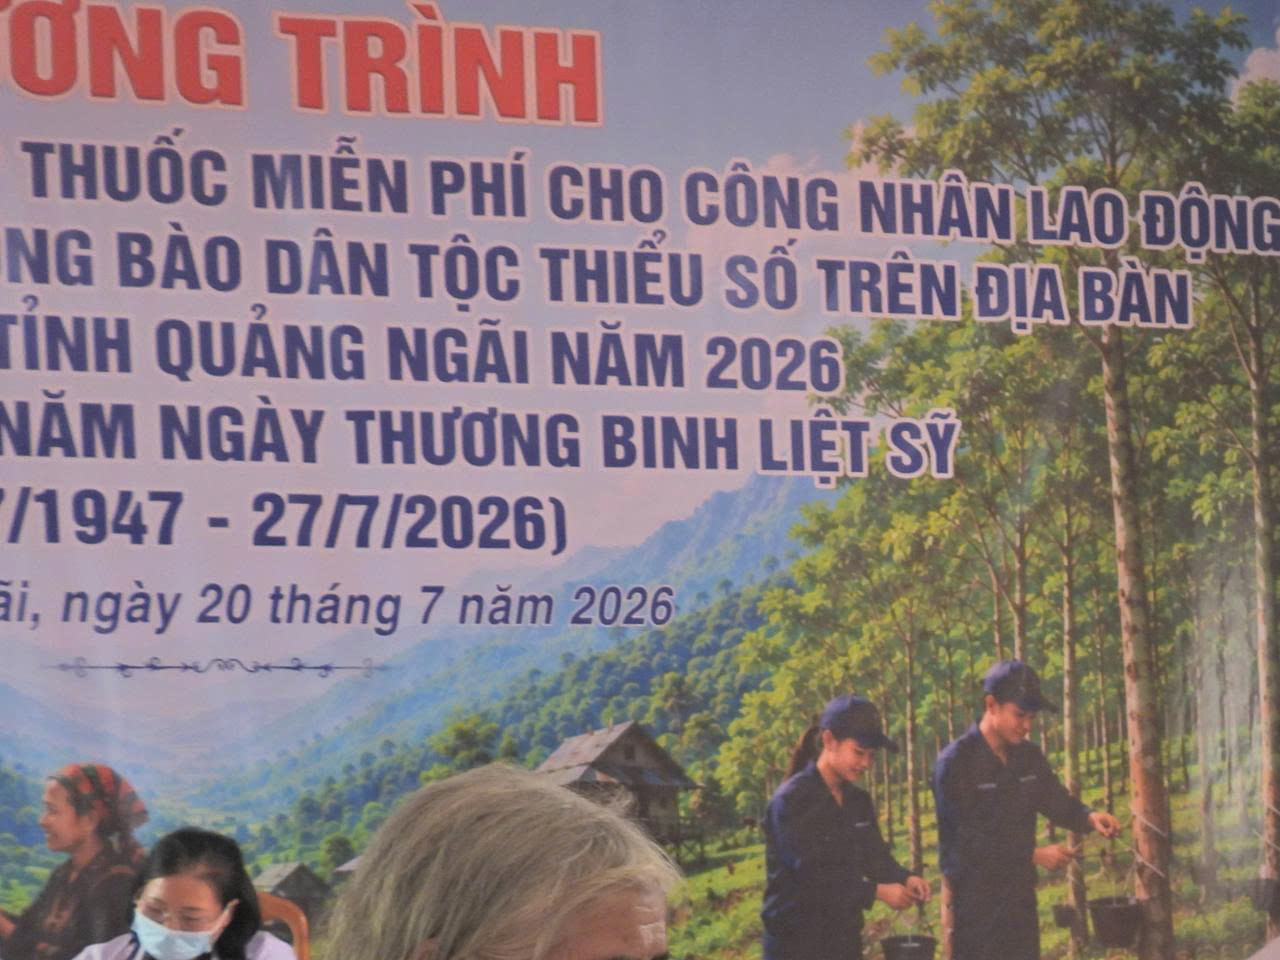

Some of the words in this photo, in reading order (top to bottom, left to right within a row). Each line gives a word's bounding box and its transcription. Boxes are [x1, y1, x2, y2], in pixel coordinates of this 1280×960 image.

[0, 0, 243, 105] ƠNG
[280, 3, 598, 122] TRÌNH
[21, 129, 227, 206] THUỐC
[252, 136, 408, 213] MIỄN
[430, 151, 528, 218] PHÍ
[548, 165, 664, 224] CHO
[685, 163, 839, 232] CÔNG
[860, 170, 1012, 241] NHÂN
[1030, 190, 1124, 246] LAO
[0, 228, 93, 287] NG
[118, 222, 241, 291] BÀO
[266, 228, 389, 297] DÂN
[410, 234, 519, 313] TỘC
[540, 229, 703, 306] THIỂU
[724, 237, 799, 311] SỐ
[816, 250, 957, 318] TRÊN
[974, 265, 1066, 331] ĐỊA
[1082, 259, 1190, 326] BÀN
[0, 294, 132, 373] TỈNH
[156, 303, 366, 382] QUẢNG
[388, 318, 527, 385] NGÃI
[551, 321, 685, 388] NĂM
[706, 337, 841, 392] 2026
[0, 389, 137, 460] NĂM
[161, 395, 324, 464] NGÀY
[346, 406, 581, 468] THƯƠNG
[602, 415, 738, 471] BINH
[760, 411, 870, 485] LIỆT
[889, 411, 958, 477] SỸ
[0, 487, 183, 546] /1947
[208, 517, 229, 528] -
[252, 493, 568, 556] 27/7/2026)
[61, 579, 181, 634] ngày
[199, 583, 251, 624] 20
[269, 582, 401, 636] tháng
[420, 585, 443, 625] 7
[458, 584, 553, 625] năm
[571, 585, 674, 626] 2026
